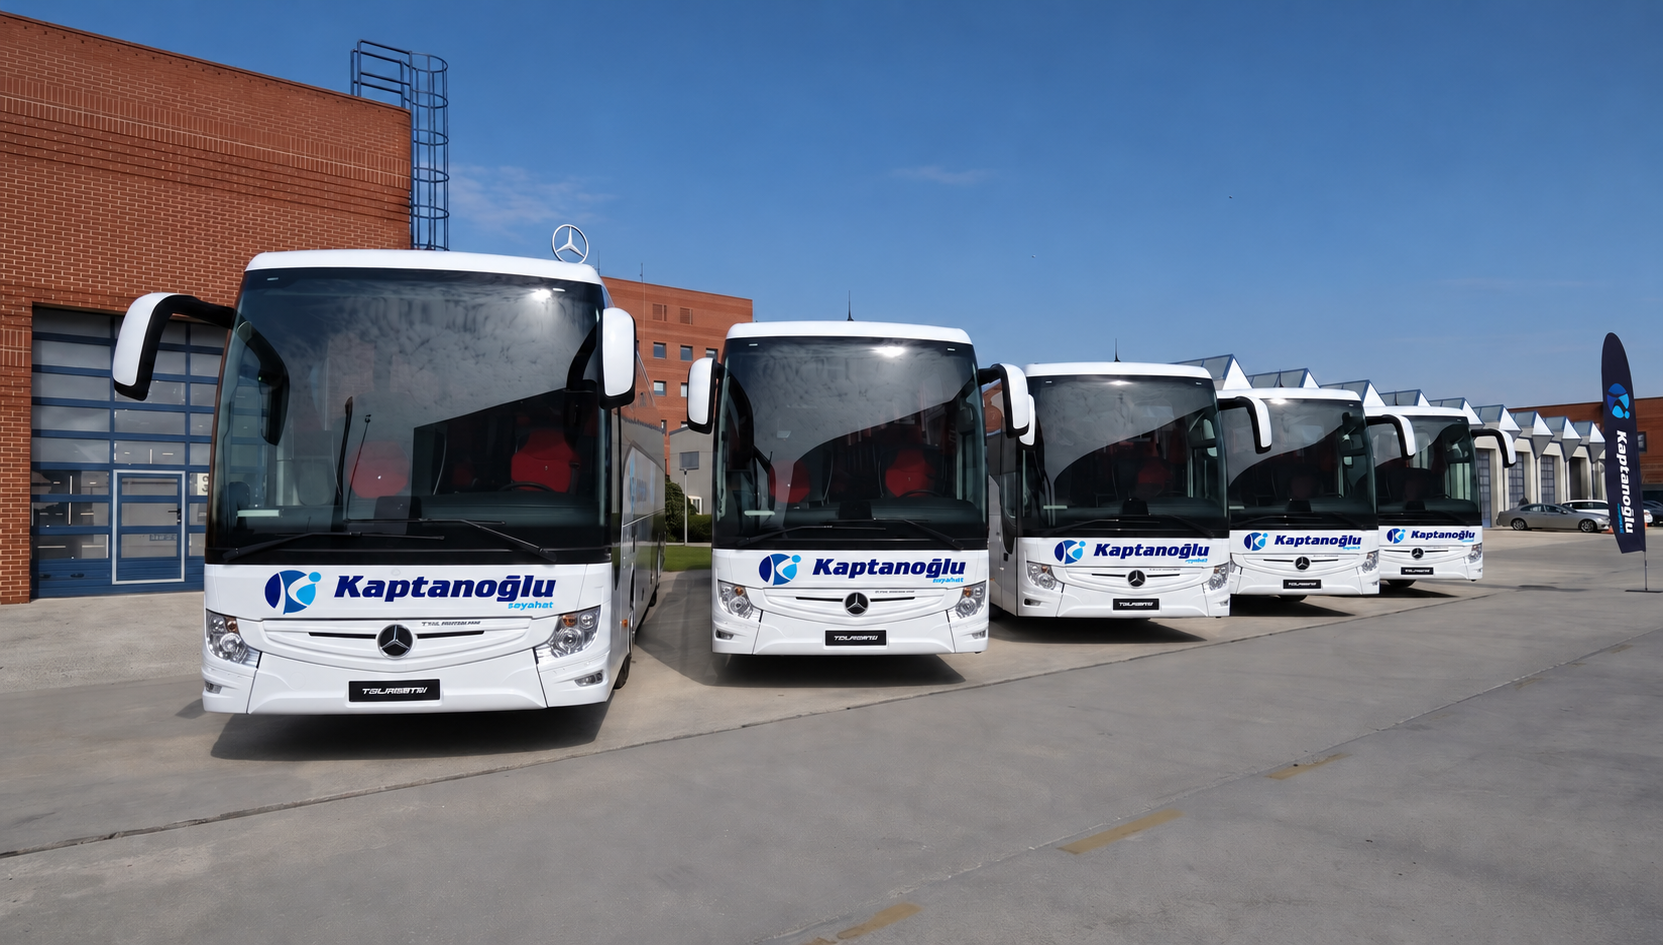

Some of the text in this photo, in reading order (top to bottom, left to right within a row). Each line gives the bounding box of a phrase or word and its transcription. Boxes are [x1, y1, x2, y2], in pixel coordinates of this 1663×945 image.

[1616, 430, 1635, 534] Kaptanoğlu
[1274, 535, 1362, 547] Kaptanoğlu
[1411, 530, 1475, 540] Kaptanoğlu
[1094, 543, 1210, 559] Kaptanoğlu
[812, 558, 966, 578] Kaptanoğlu
[334, 575, 556, 602] Kaptanoğlu
